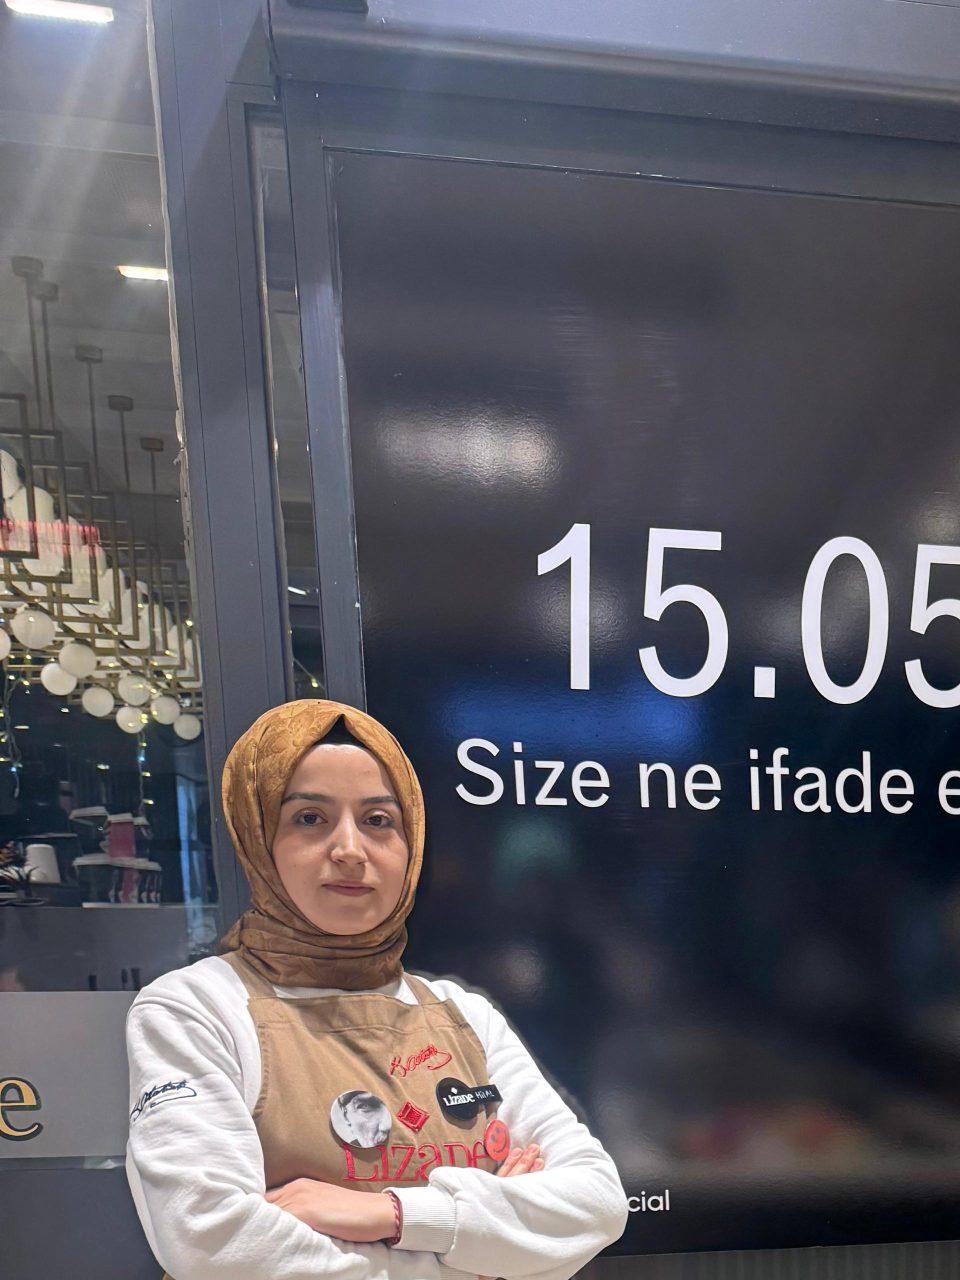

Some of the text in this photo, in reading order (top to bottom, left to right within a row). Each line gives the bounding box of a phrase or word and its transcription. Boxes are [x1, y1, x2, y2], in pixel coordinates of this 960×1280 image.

[455, 738, 610, 808] Size
[639, 762, 722, 811] ne
[749, 747, 915, 814] ifade
